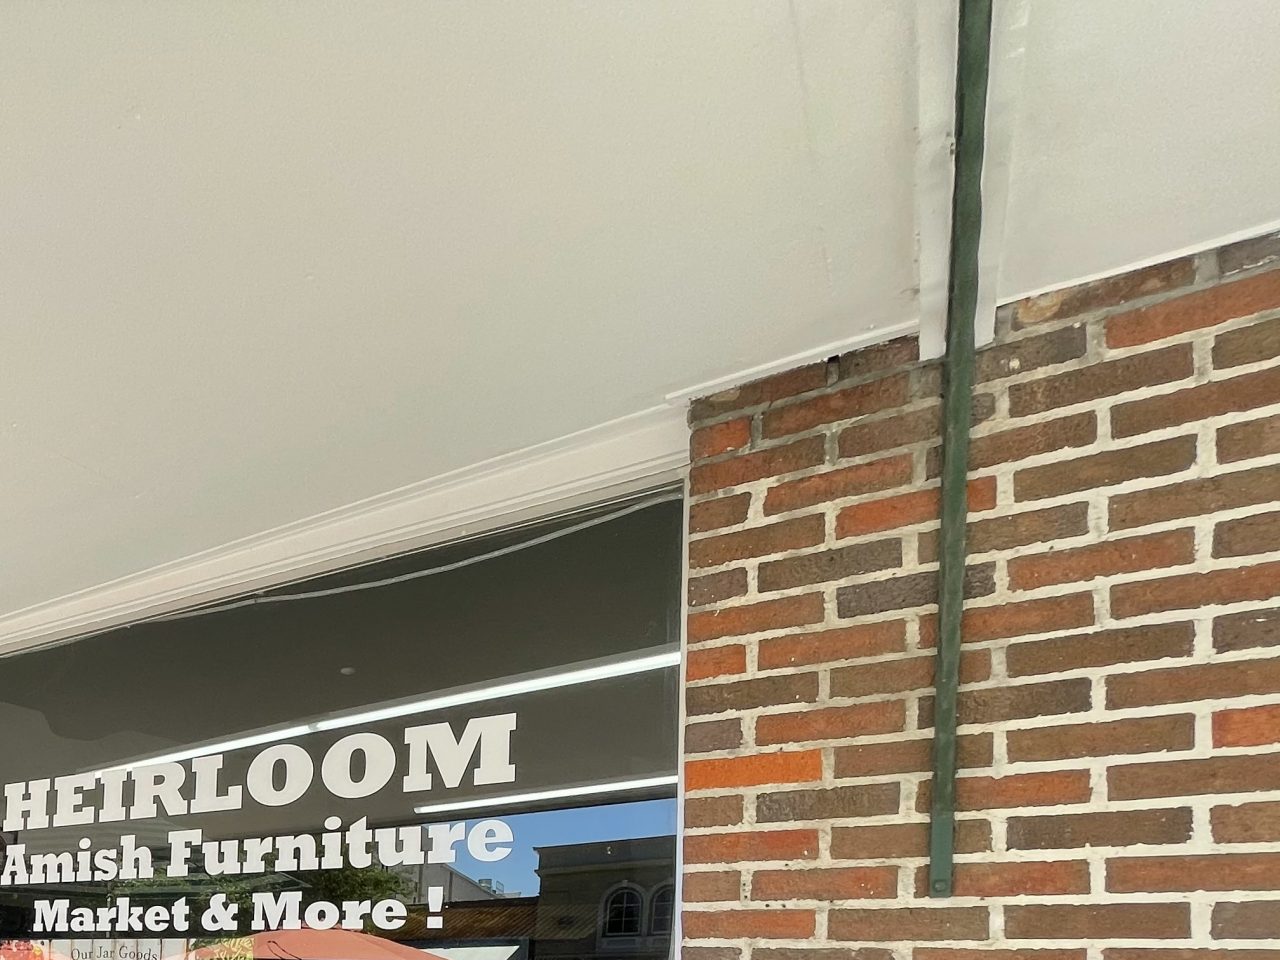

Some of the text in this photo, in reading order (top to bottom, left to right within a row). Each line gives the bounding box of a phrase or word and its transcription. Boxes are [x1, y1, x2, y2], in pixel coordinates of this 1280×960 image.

[3, 712, 518, 833] HEIRLOOM
[0, 815, 514, 886] Amish Furniture
[33, 896, 190, 933] Market
[201, 893, 238, 931] &
[252, 891, 408, 931] More
[71, 947, 93, 960] Our
[96, 946, 114, 959] Jar
